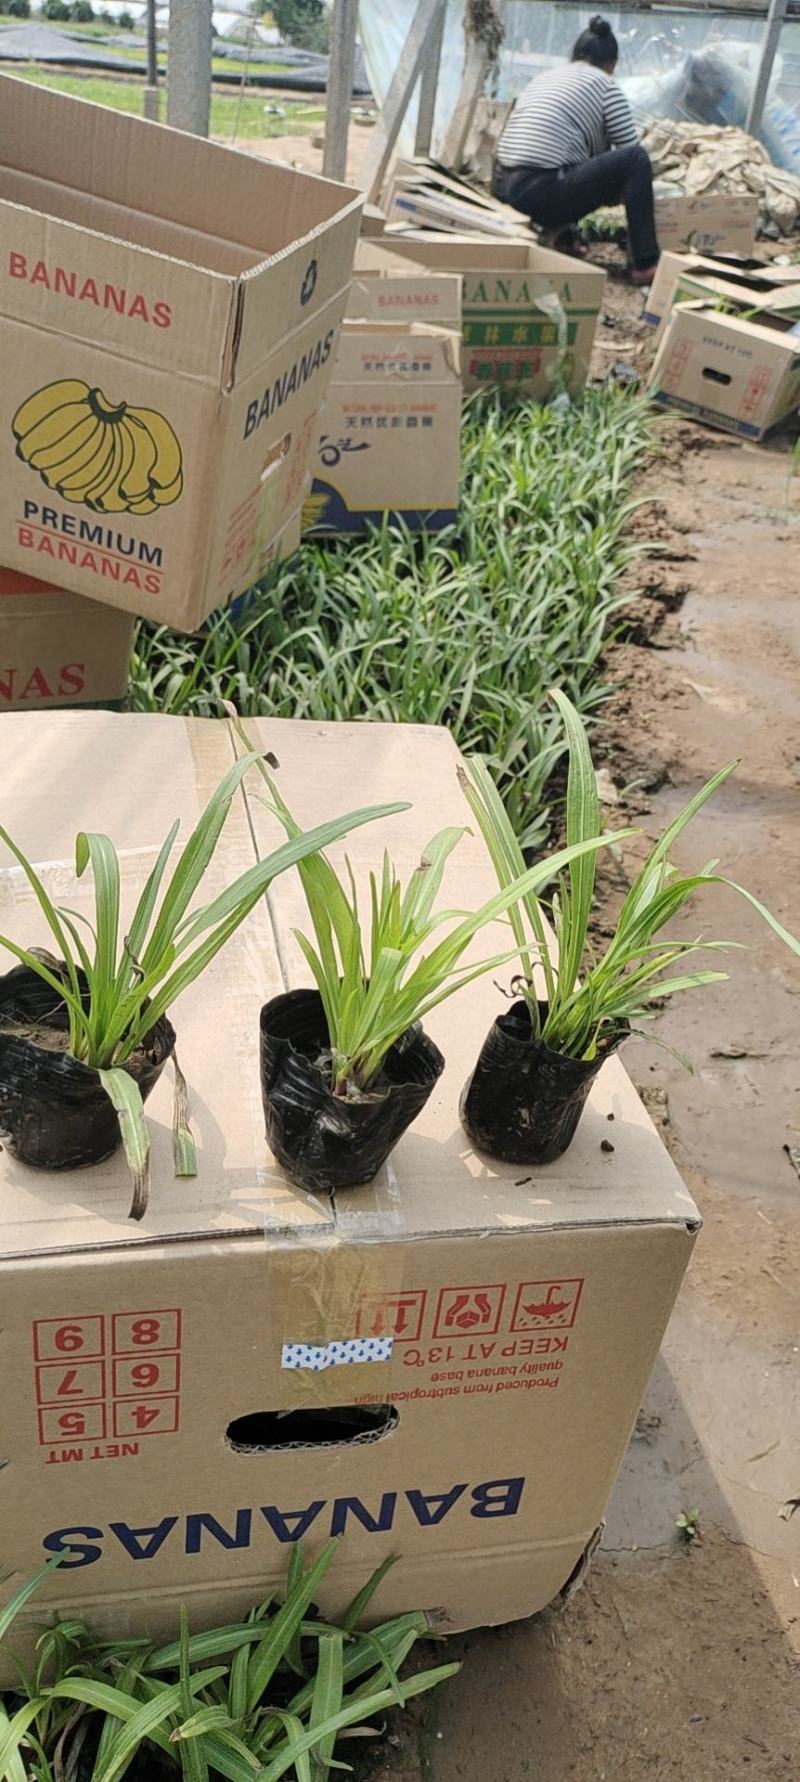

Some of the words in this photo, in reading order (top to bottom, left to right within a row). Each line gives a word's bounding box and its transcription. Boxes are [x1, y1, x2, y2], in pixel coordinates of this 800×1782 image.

[9, 252, 173, 328] BANANAS
[378, 294, 440, 307] BANANAS
[463, 280, 571, 302] ANAA
[244, 329, 335, 439] BANANAS
[23, 500, 163, 567] PREMIUM
[18, 527, 161, 595] BANANAS
[54, 1325, 84, 1351] 9
[131, 1319, 160, 1345] 8
[462, 1343, 497, 1361] AT
[501, 1336, 568, 1357] KEEP
[131, 1363, 160, 1388] 6
[430, 1370, 464, 1384] base
[467, 1364, 518, 1381] banana
[519, 1359, 564, 1376] quality
[57, 1370, 84, 1396] 7
[386, 1386, 460, 1402] subtropical
[464, 1383, 494, 1395] from
[496, 1377, 559, 1393] Produced
[58, 1412, 85, 1436] 5
[131, 1405, 161, 1429] 4
[45, 1449, 83, 1464] MT
[90, 1442, 139, 1460] NET
[42, 1477, 525, 1569] BANANAS
